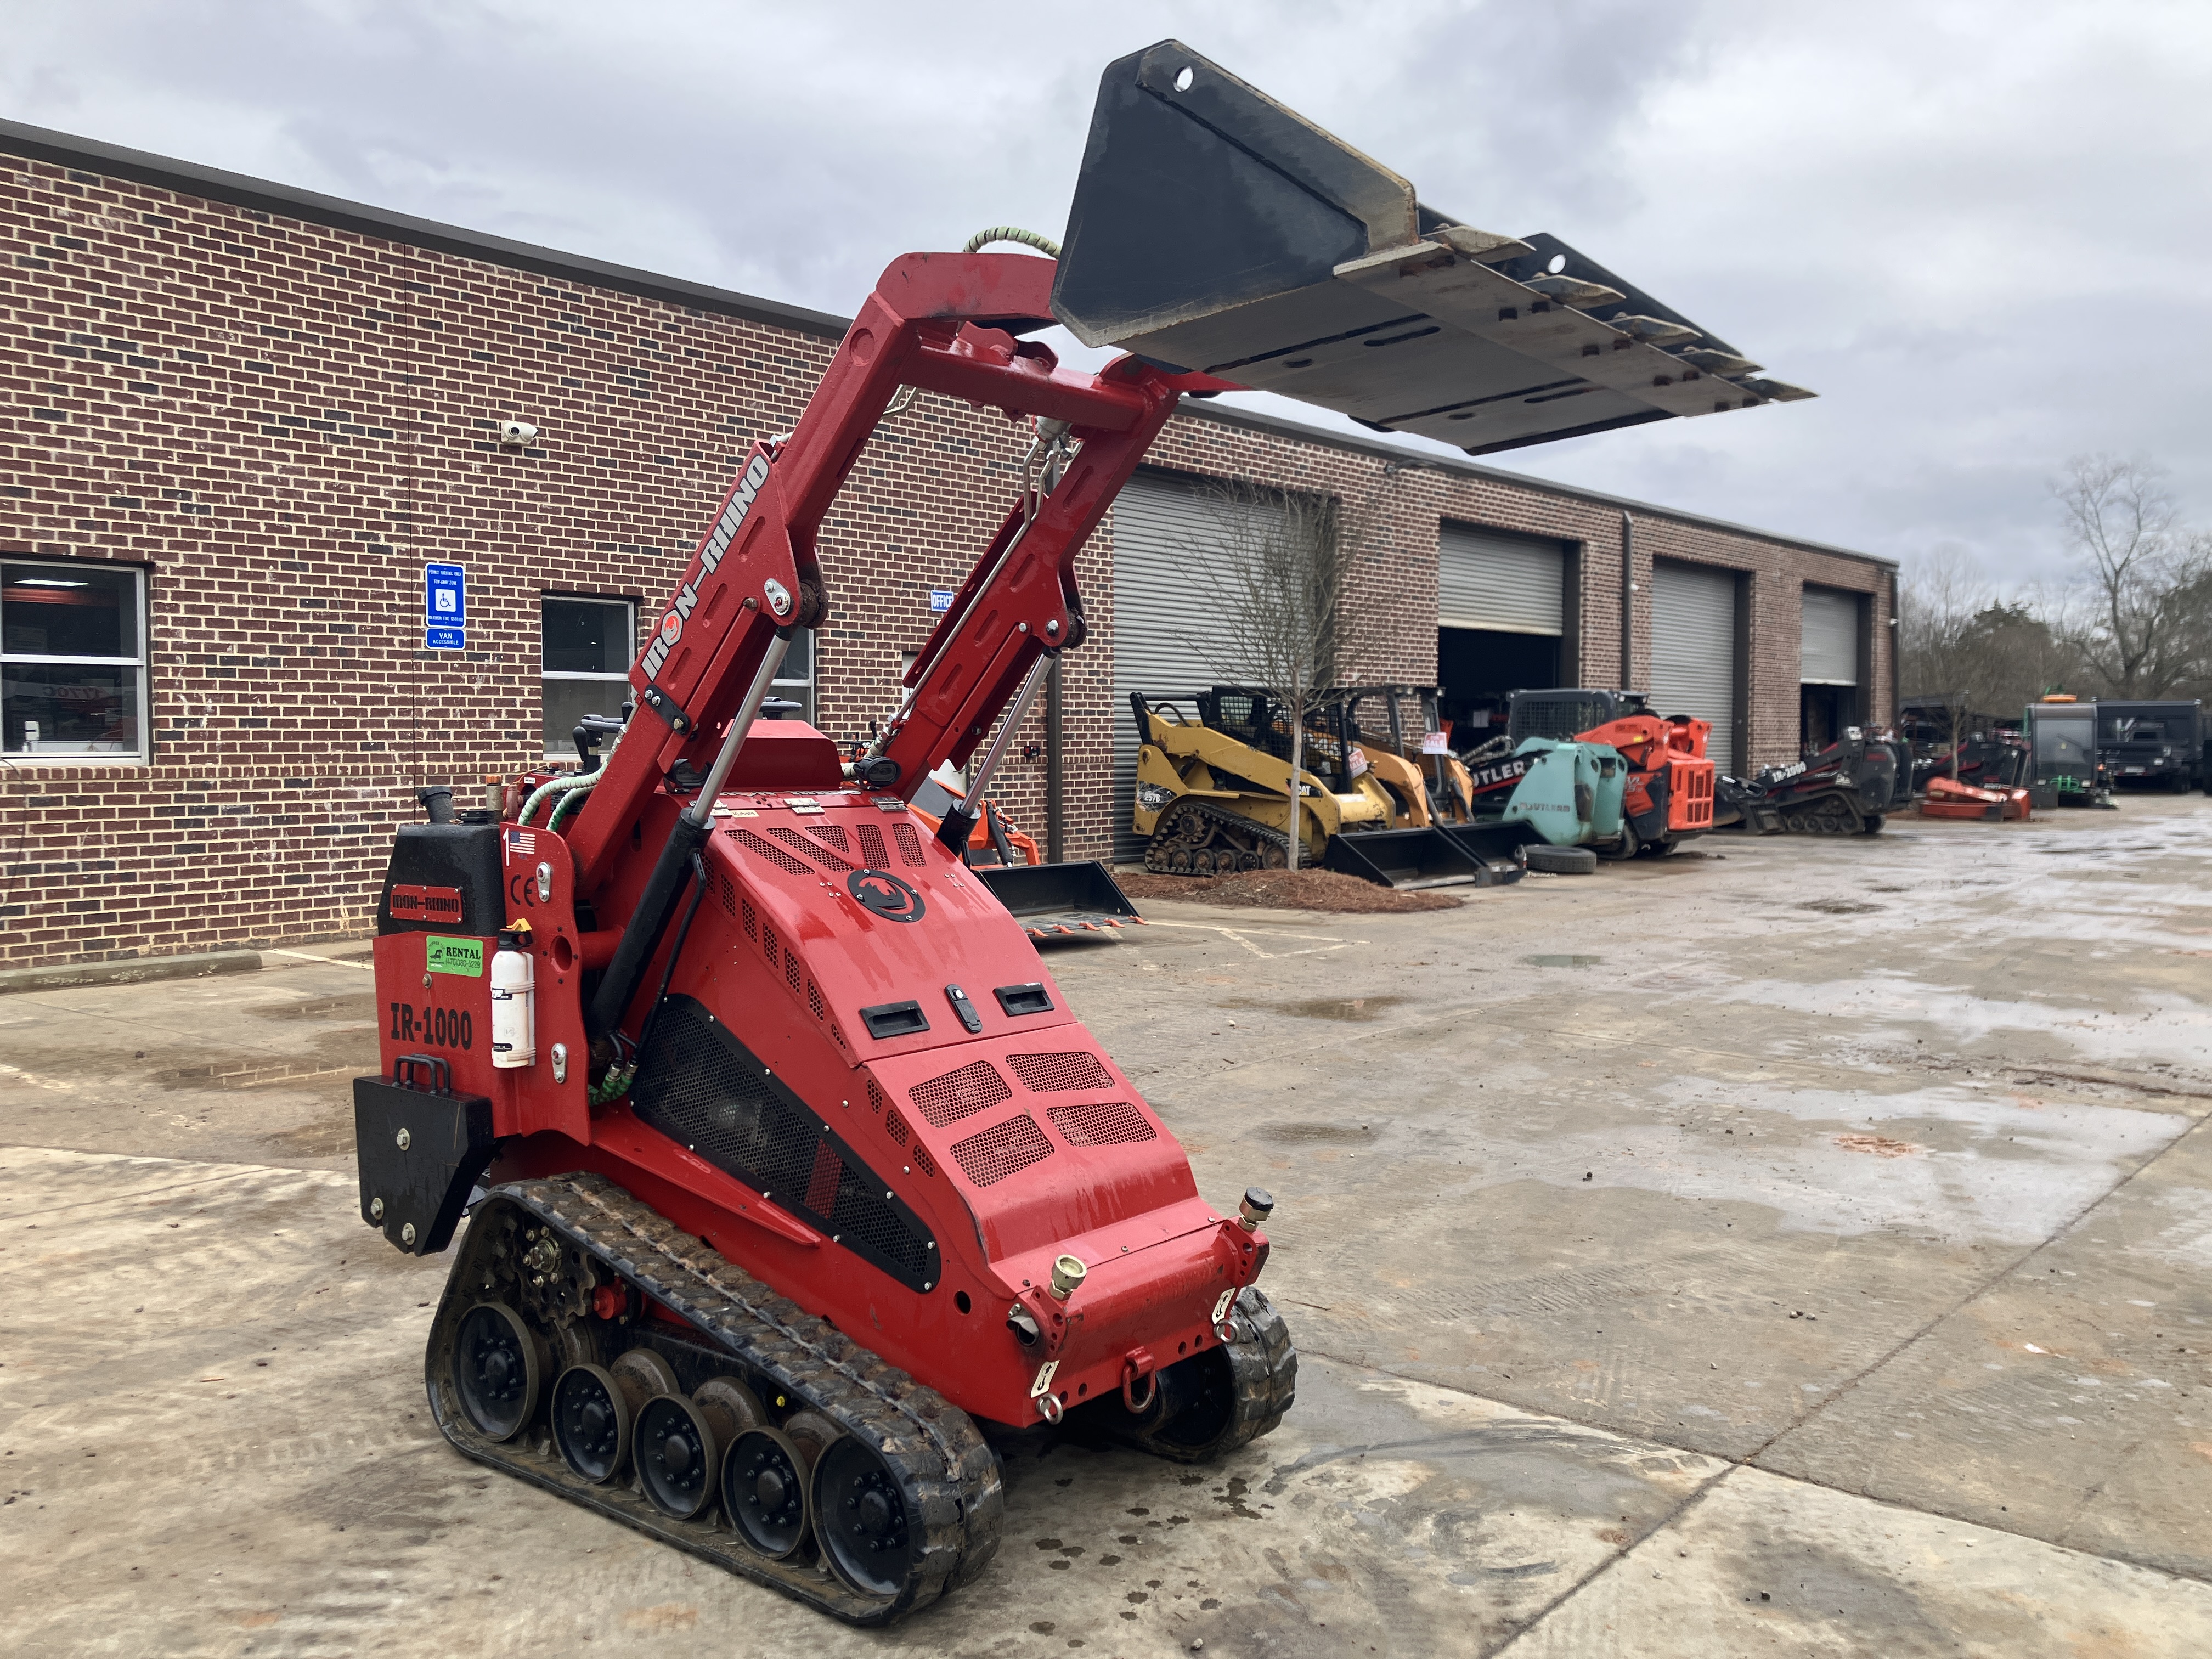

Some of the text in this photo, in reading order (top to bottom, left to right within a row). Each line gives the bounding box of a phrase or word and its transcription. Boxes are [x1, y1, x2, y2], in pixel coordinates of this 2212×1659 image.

[641, 454, 769, 682] IRON-RHINO
[933, 594, 952, 607] OFFICE
[1144, 791, 1160, 802] 257B
[510, 874, 534, 907] CE
[393, 895, 459, 913] IRON-RHINO
[445, 946, 481, 959] RENTAL
[391, 1002, 472, 1051] IR-1000
